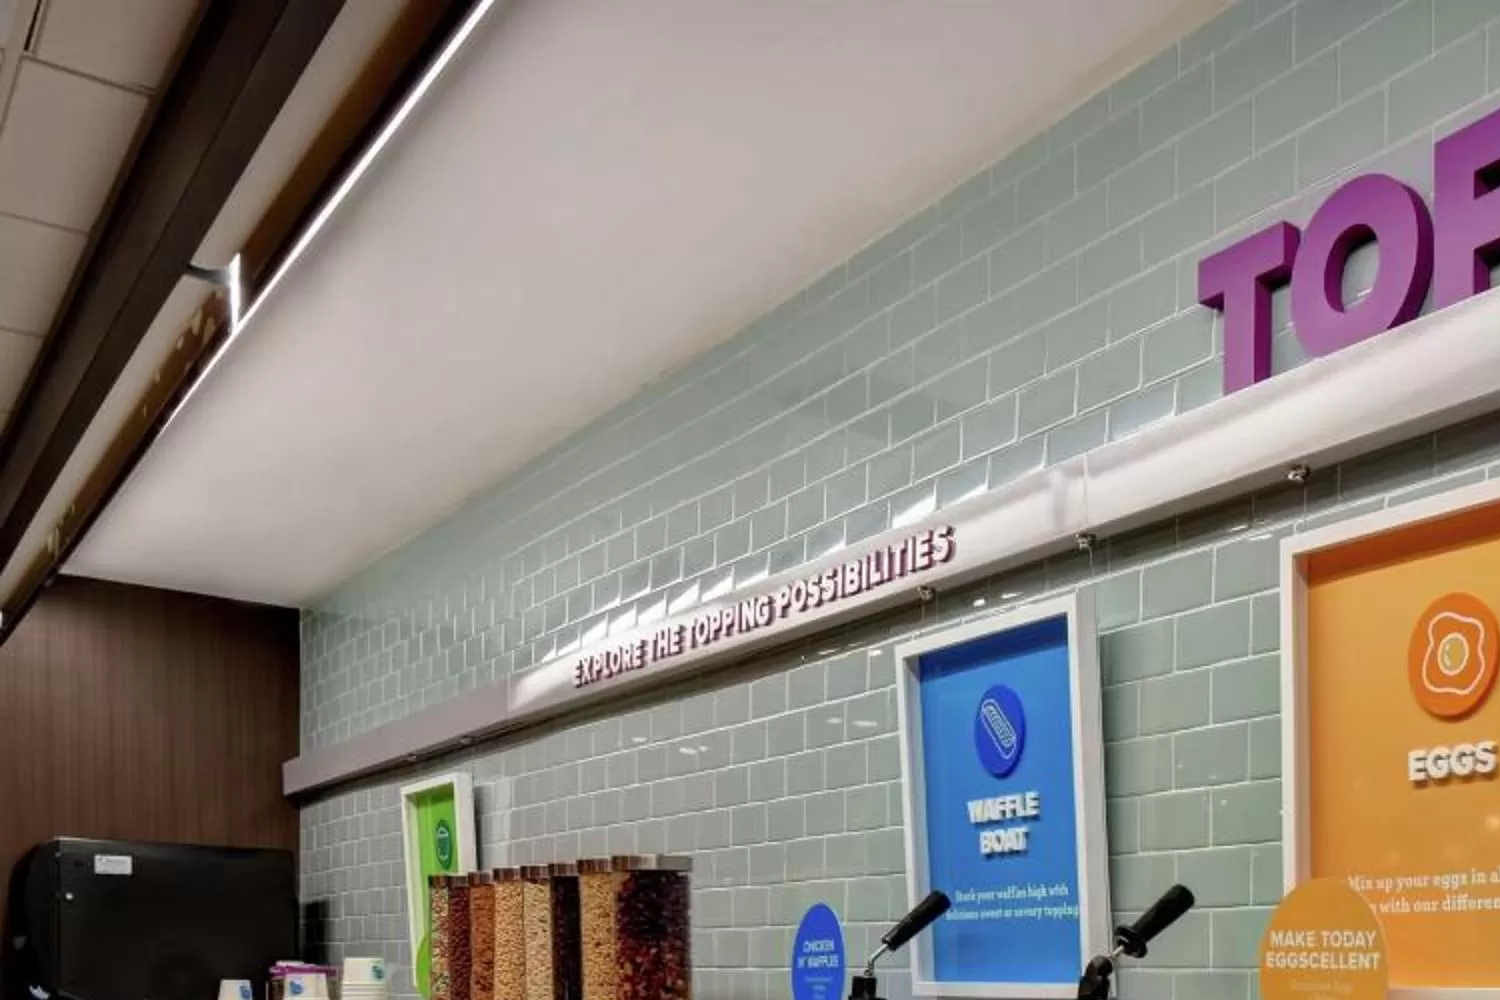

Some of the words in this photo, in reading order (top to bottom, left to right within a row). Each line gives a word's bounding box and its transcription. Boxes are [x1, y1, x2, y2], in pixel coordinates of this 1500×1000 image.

[575, 640, 647, 688] EXPLORE
[649, 625, 686, 661] THE
[689, 596, 777, 650] TOPPING
[776, 526, 956, 619] POSSIBILITIES
[1408, 740, 1499, 785] EGGS
[967, 791, 1040, 824] WAFFLE
[979, 828, 1030, 857] BOAT
[1376, 877, 1393, 893] up
[1395, 875, 1430, 892] your
[1433, 871, 1468, 890] eggs
[1471, 868, 1487, 884] in
[1379, 898, 1411, 915] with
[1413, 899, 1440, 912] our
[1270, 930, 1315, 948] MAKE
[1322, 929, 1377, 948] TODAY
[1265, 951, 1381, 970] EGGSCELLENT
